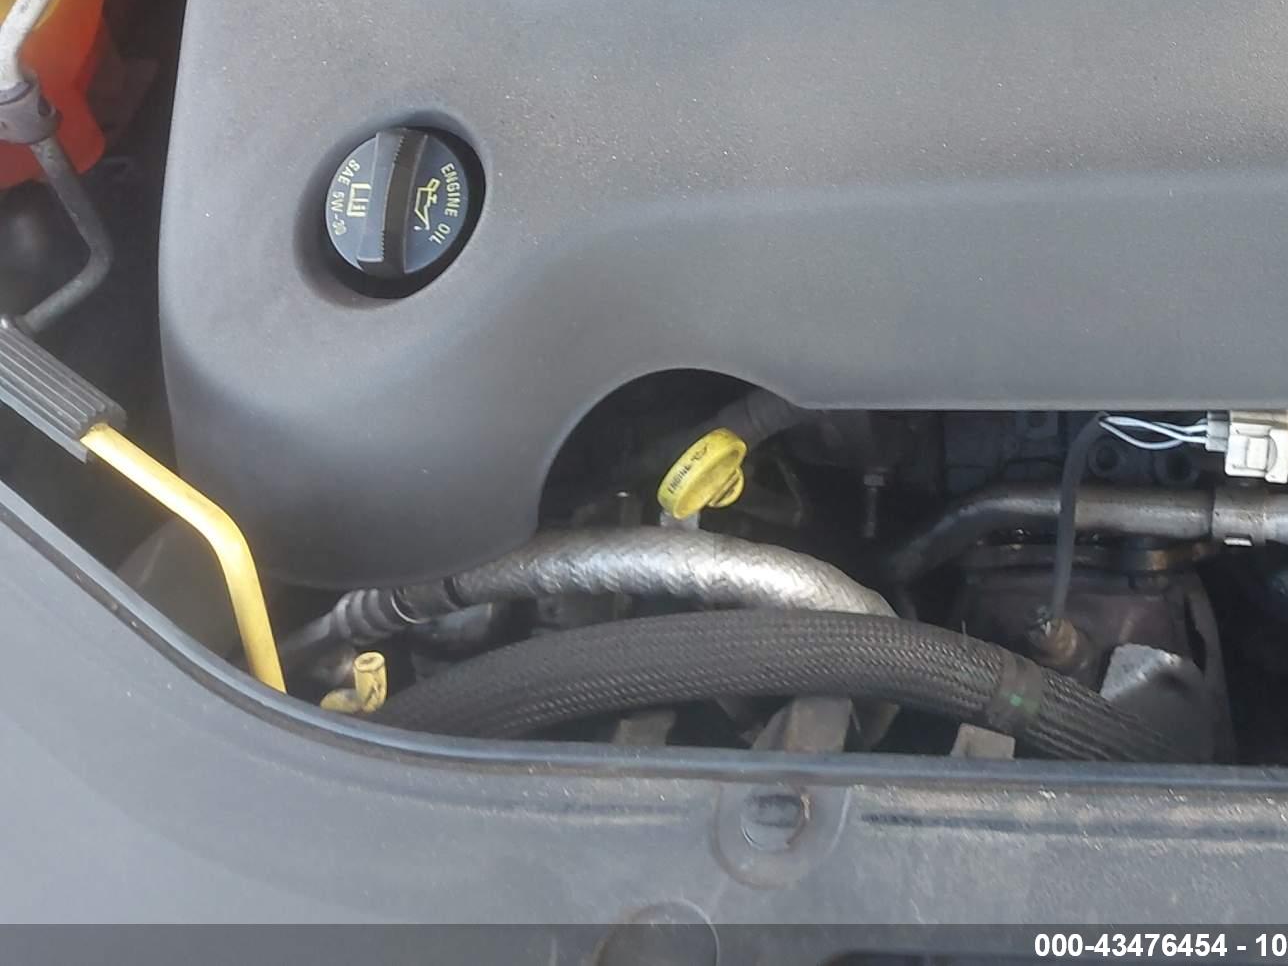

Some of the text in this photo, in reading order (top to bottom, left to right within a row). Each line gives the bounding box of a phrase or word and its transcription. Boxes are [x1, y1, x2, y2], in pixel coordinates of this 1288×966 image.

[337, 159, 361, 186] SAE
[427, 162, 462, 246] ENGINE OIL
